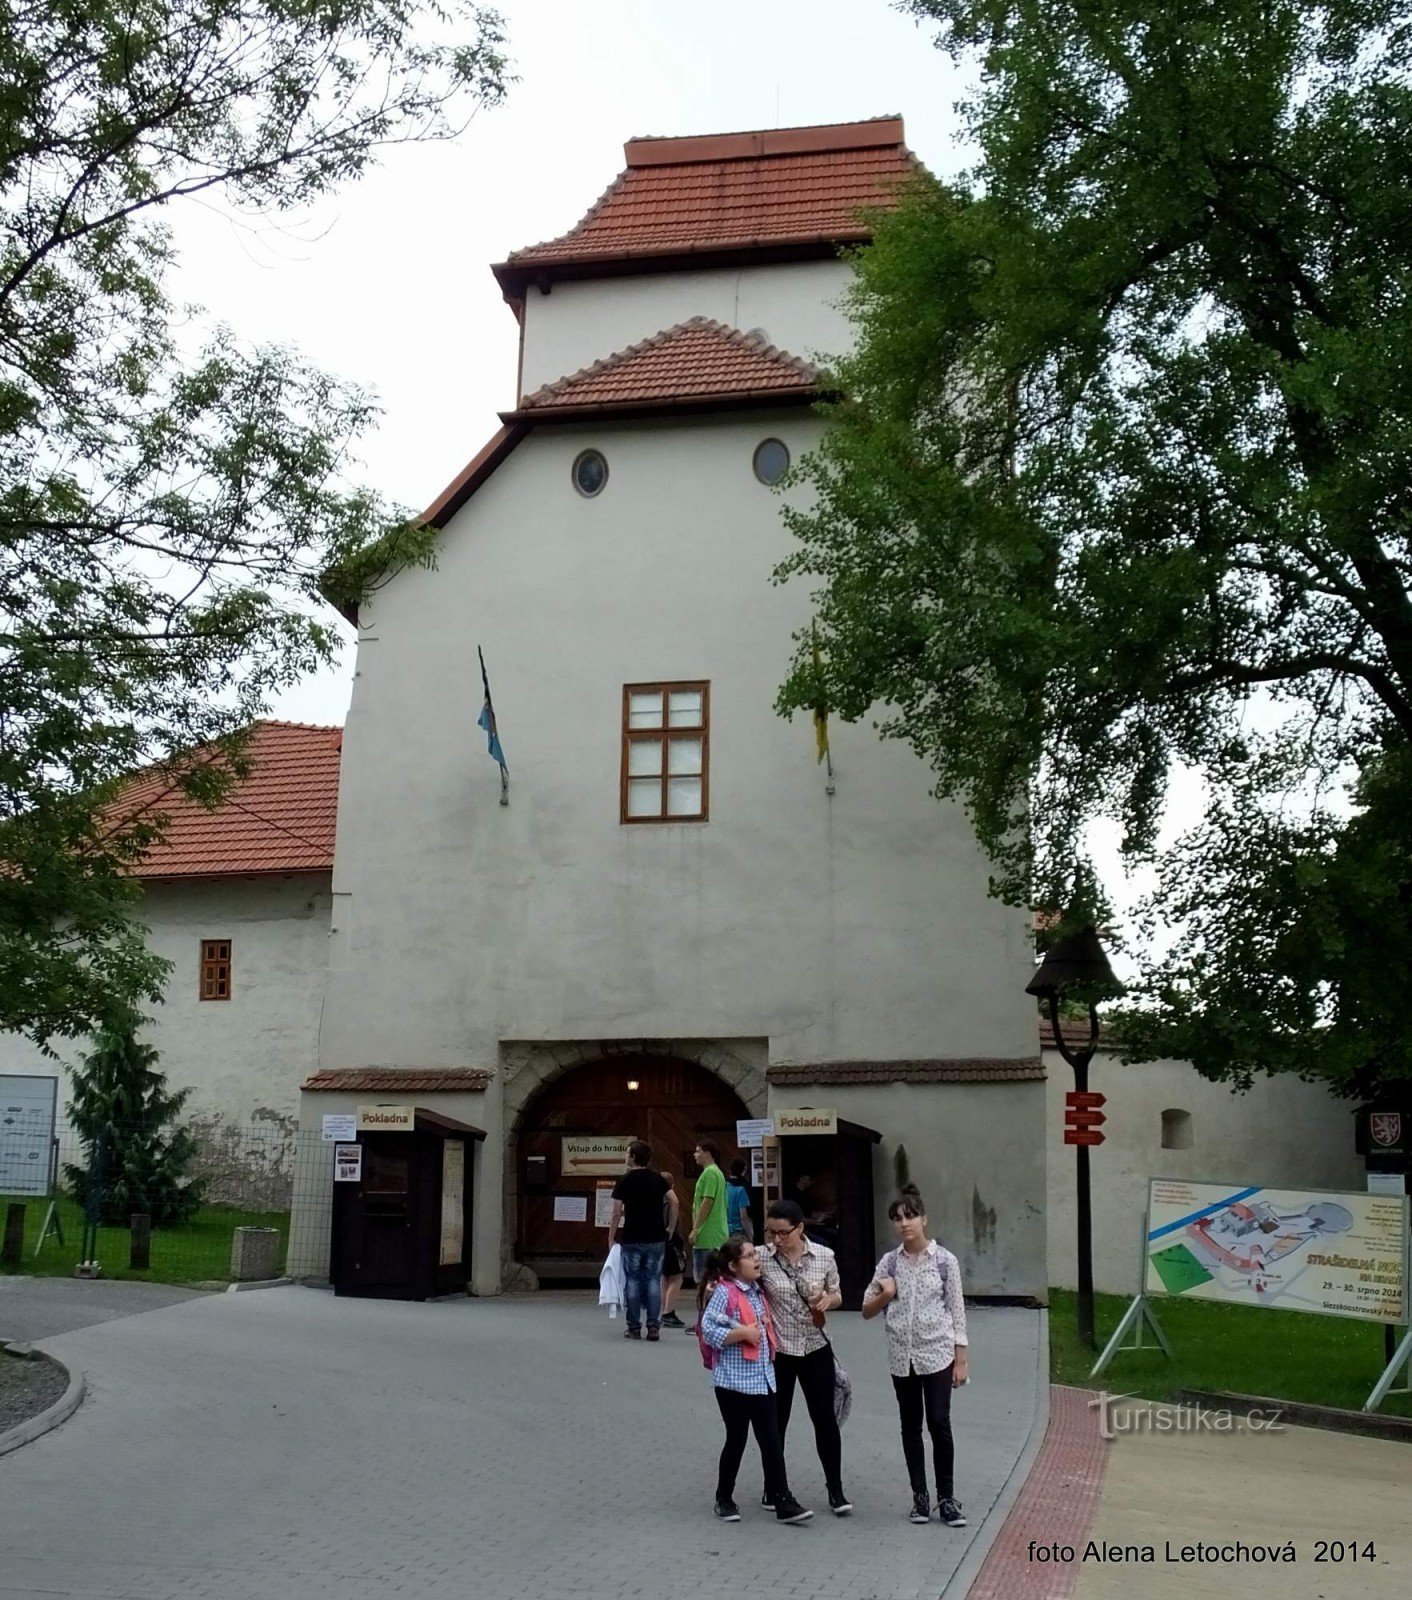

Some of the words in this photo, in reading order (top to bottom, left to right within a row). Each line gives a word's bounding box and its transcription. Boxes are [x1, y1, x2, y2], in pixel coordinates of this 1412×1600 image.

[362, 1112, 409, 1124] Pokladna
[780, 1116, 831, 1128] Pokladna
[567, 1144, 591, 1154] Vstup
[592, 1144, 602, 1152] do
[604, 1144, 628, 1152] hradu
[1322, 1281, 1335, 1290] 29.
[1343, 1284, 1356, 1293] 30.
[1357, 1286, 1380, 1296] srpna
[1381, 1288, 1402, 1298] 2014
[1383, 1308, 1402, 1318] hrad
